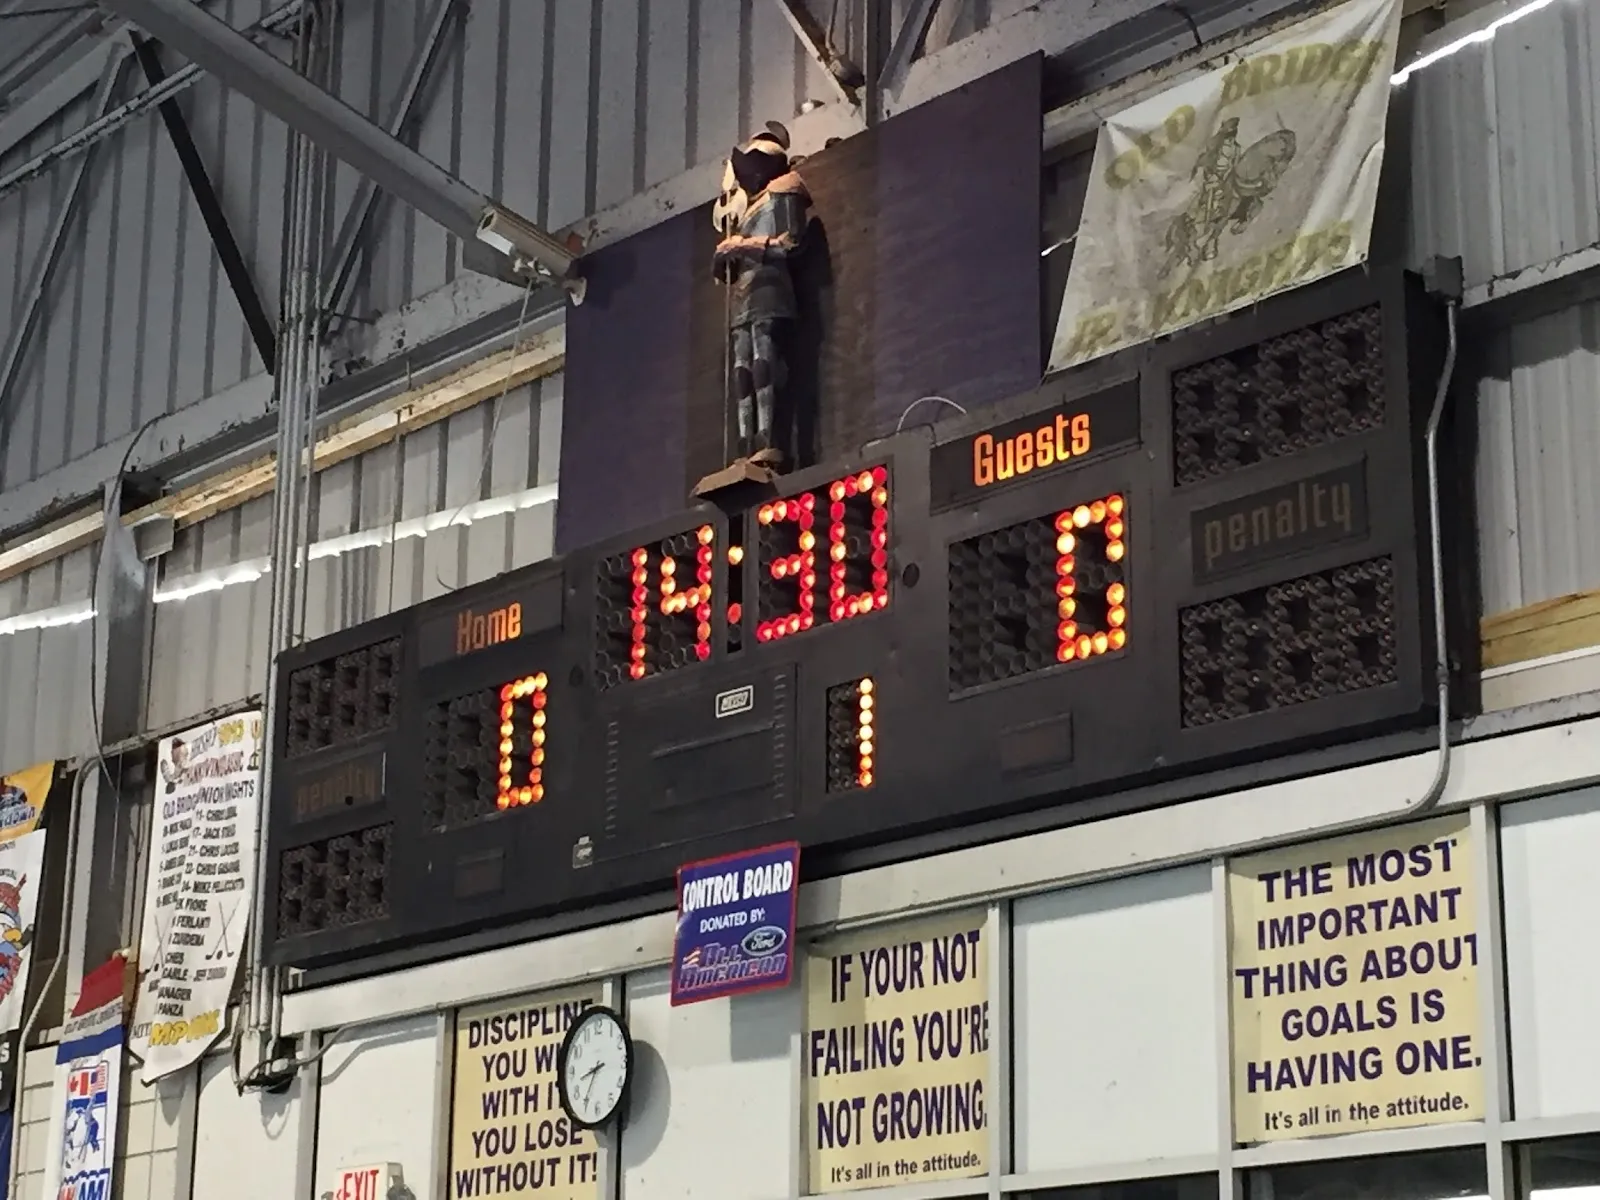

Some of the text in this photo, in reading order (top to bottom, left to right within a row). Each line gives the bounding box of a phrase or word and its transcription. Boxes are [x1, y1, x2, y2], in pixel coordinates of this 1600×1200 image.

[974, 414, 1090, 486] Guests
[1205, 483, 1351, 568] penalty
[1056, 493, 1125, 662] 0
[457, 603, 521, 655] Home
[497, 671, 548, 810] 0
[682, 860, 794, 913] CONTROL BOARD
[1258, 838, 1457, 903] THE MOST
[700, 911, 747, 933] DONATED
[751, 931, 777, 950] Ford
[1257, 886, 1462, 951] IMPORTANT
[831, 929, 980, 1003] IF YOUR NOT
[1235, 933, 1478, 999] THING ABOUT
[468, 998, 593, 1049] DISCIPLIN
[811, 1001, 989, 1077] FAILING YOU'RE
[1281, 988, 1445, 1041] GOALS IS
[482, 1042, 561, 1083] YOU WI
[1247, 1035, 1482, 1093] HAVING ONE.
[482, 1083, 539, 1120] WITH
[817, 1078, 988, 1150] NOT GROWING.
[1264, 1091, 1469, 1131] It's all in the attitude.
[472, 1117, 583, 1159] YOU LOSE
[343, 1169, 379, 1200] EXIT
[456, 1151, 598, 1199] WITHOUT IT!
[831, 1151, 981, 1183] It's all in the attitude.
